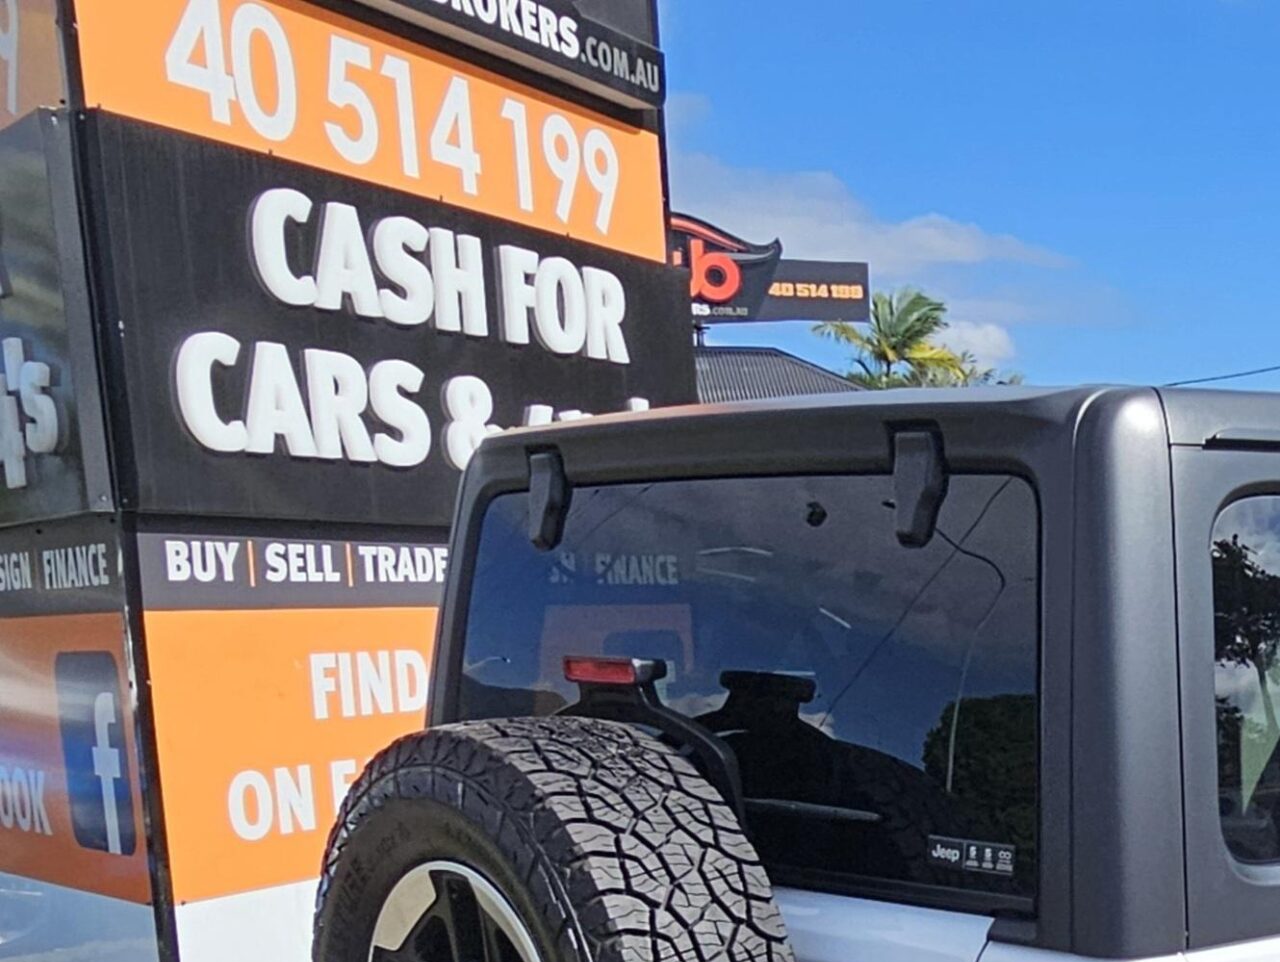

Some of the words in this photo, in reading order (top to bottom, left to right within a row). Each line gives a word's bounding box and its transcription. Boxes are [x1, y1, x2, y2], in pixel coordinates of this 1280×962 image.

[165, 0, 297, 143] 40
[323, 33, 482, 196] 514
[501, 96, 620, 236] 199
[250, 187, 489, 338] CASH
[497, 244, 631, 365] FOR
[767, 281, 795, 297] 40
[796, 283, 829, 299] 514
[174, 331, 432, 468] CARS
[42, 542, 110, 590] FINANCE
[164, 539, 240, 582] BUY
[264, 542, 342, 583] SELL
[309, 648, 430, 721] FIND
[227, 763, 317, 842] ON
[931, 843, 960, 863] Jeep
